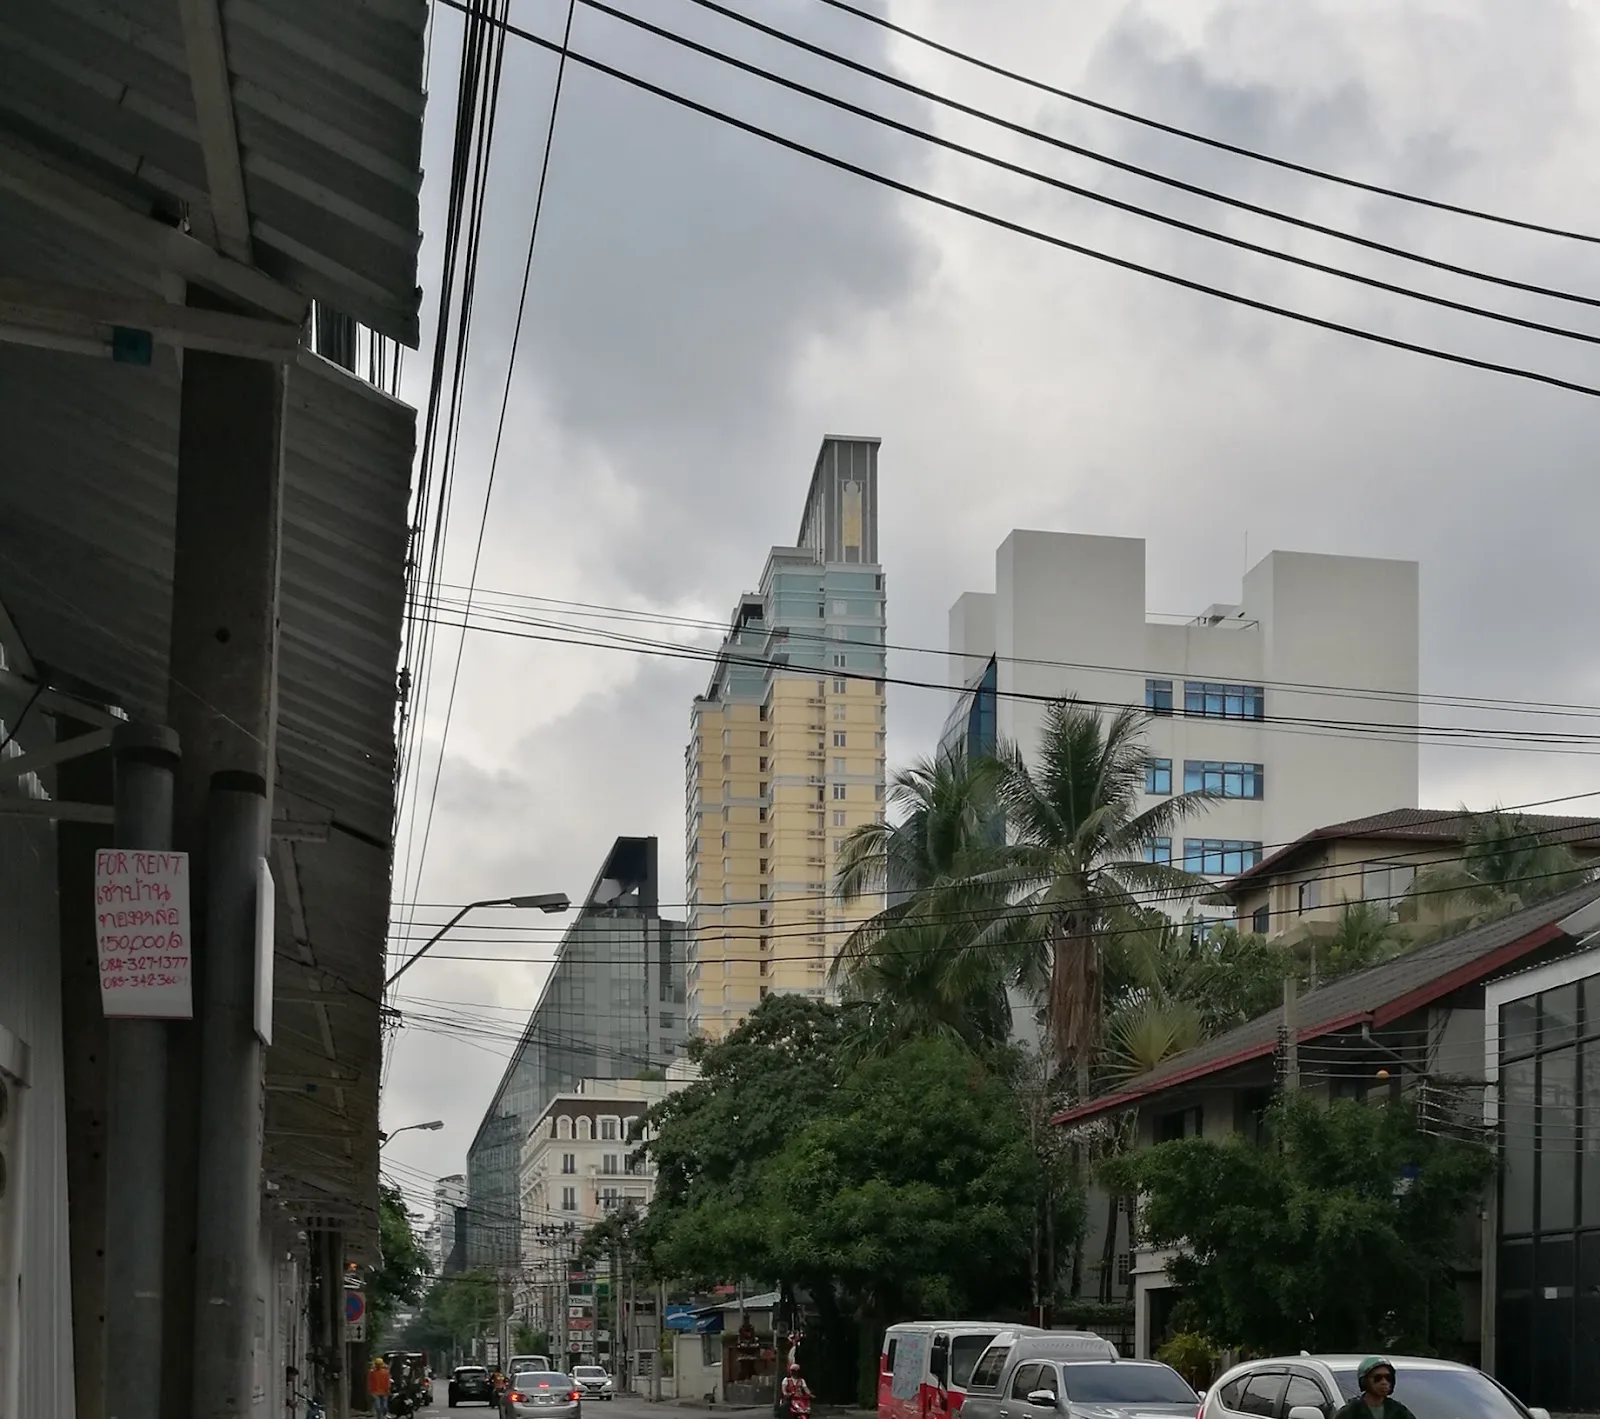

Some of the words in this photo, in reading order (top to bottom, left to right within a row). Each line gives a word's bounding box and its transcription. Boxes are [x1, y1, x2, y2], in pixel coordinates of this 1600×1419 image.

[97, 852, 128, 876] FOR
[132, 853, 183, 876] RENT
[97, 878, 171, 905] เช่าบ้าน
[98, 903, 179, 928] ทองหล่อ
